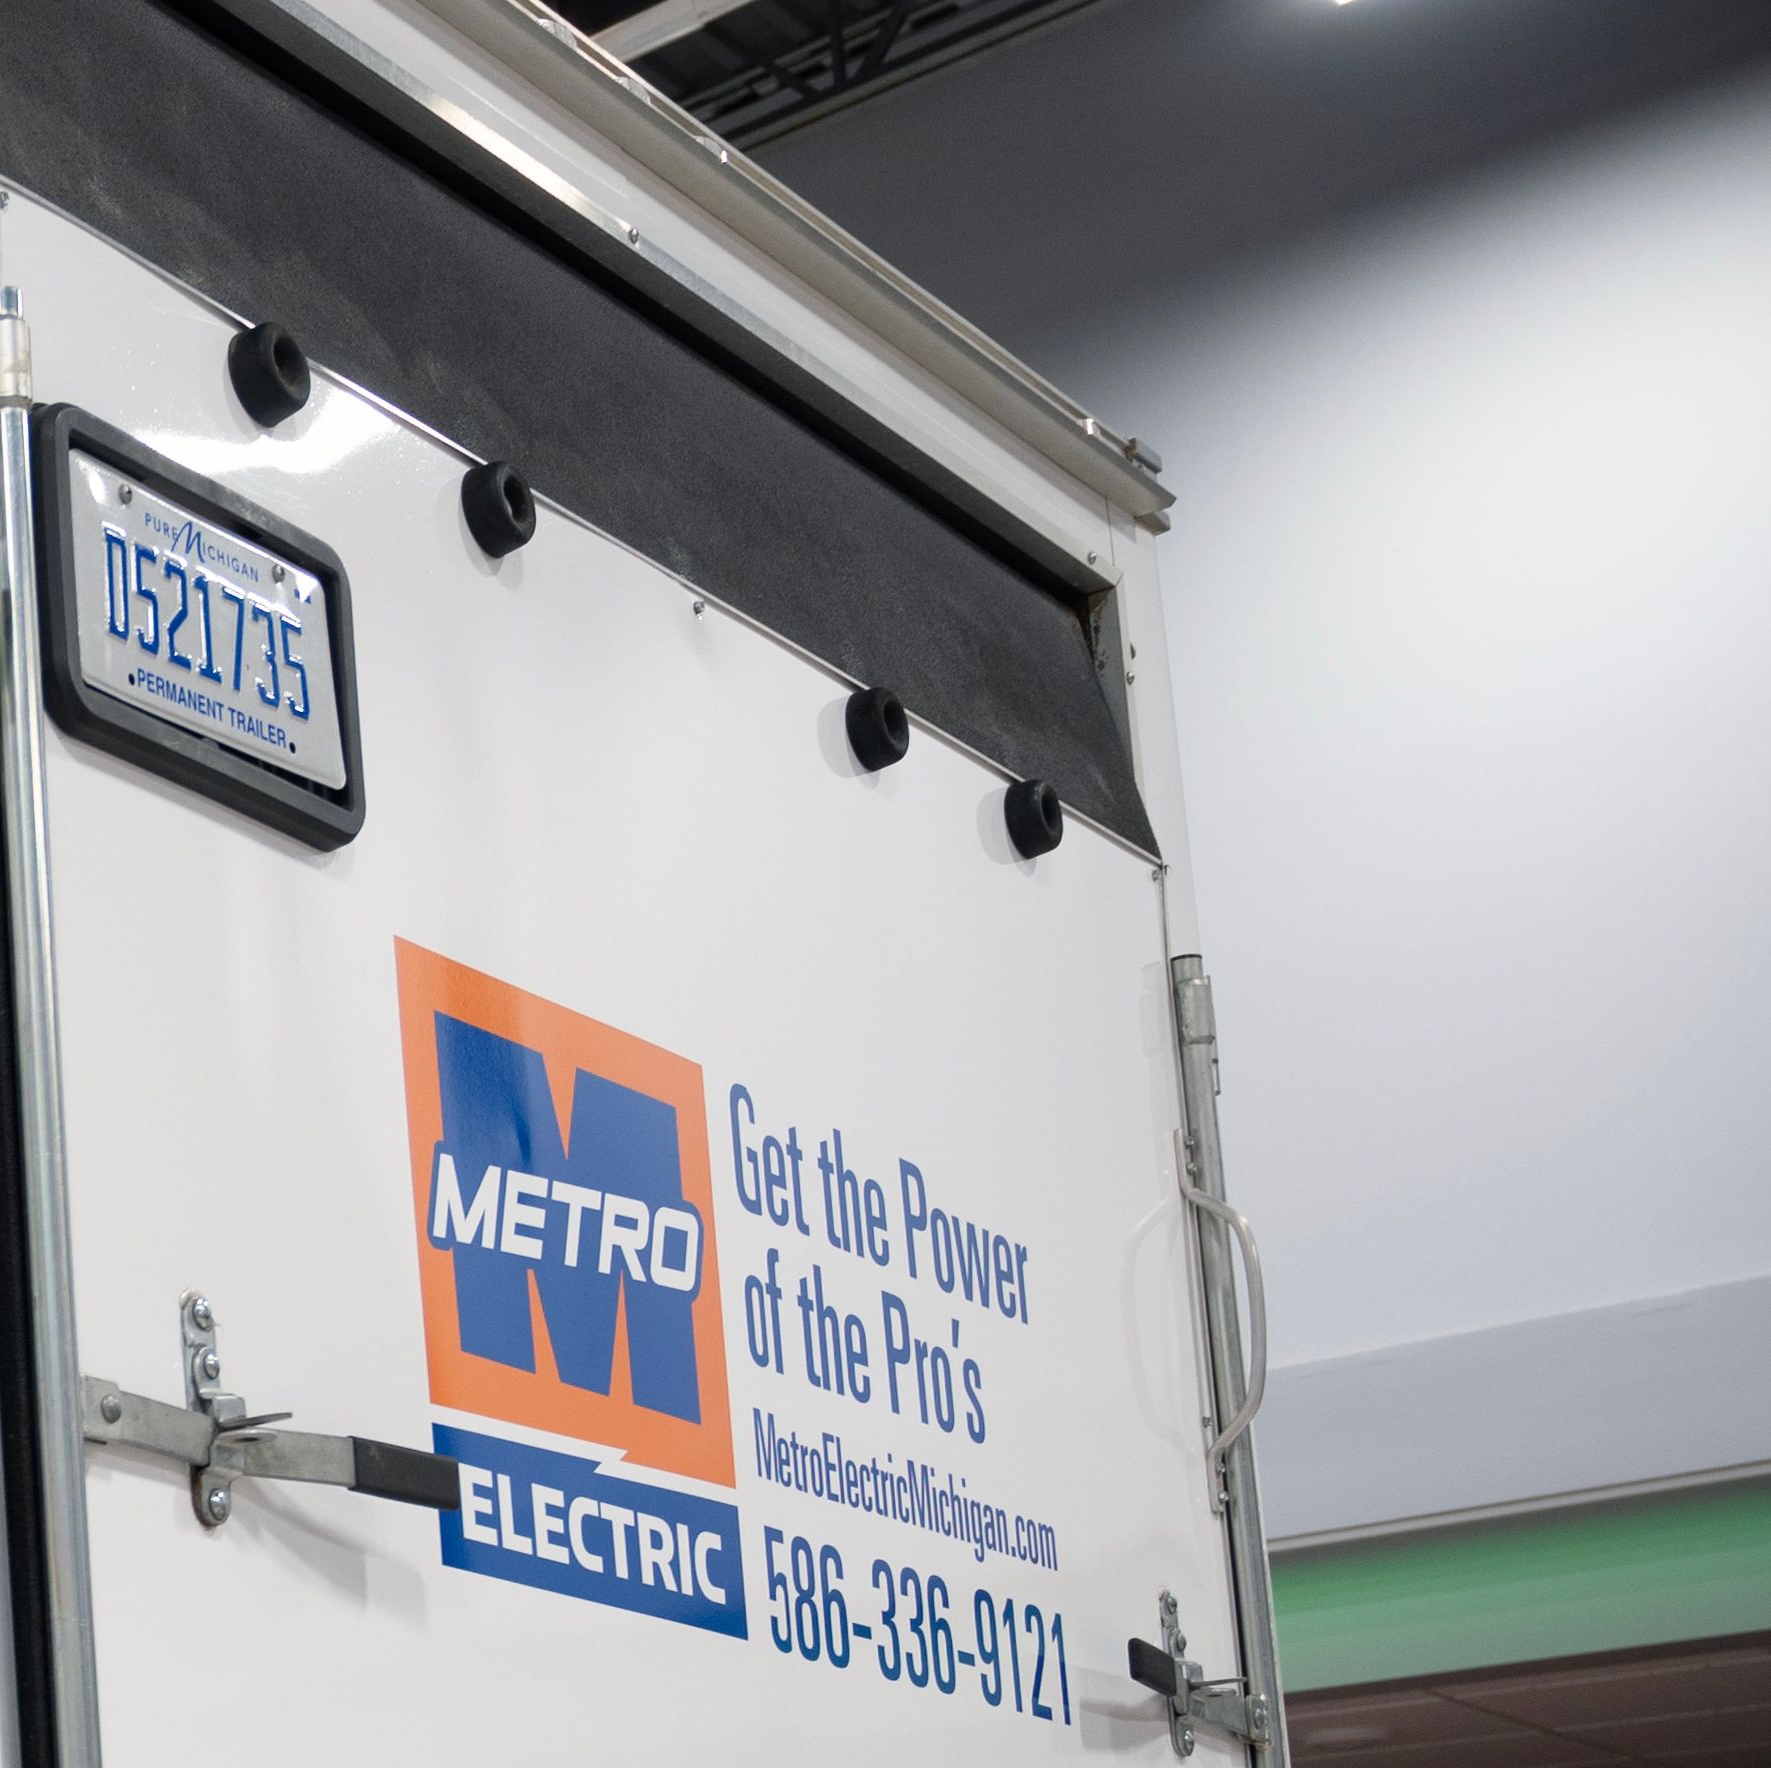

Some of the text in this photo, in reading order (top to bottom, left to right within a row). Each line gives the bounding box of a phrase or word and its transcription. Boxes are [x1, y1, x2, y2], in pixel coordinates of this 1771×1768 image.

[100, 520, 310, 720] D521735
[144, 511, 260, 583] PURE MICHIGAN
[136, 667, 288, 749] PERMANENT TRAILER
[431, 1152, 701, 1293] METRO
[728, 1083, 1031, 1326] Get the Power
[744, 1247, 986, 1446] of the Pro's
[460, 1470, 728, 1606] ELECTRIC
[752, 1407, 1059, 1571] MetroElectricMichigan.com
[763, 1524, 1072, 1727] 586-336-9121
